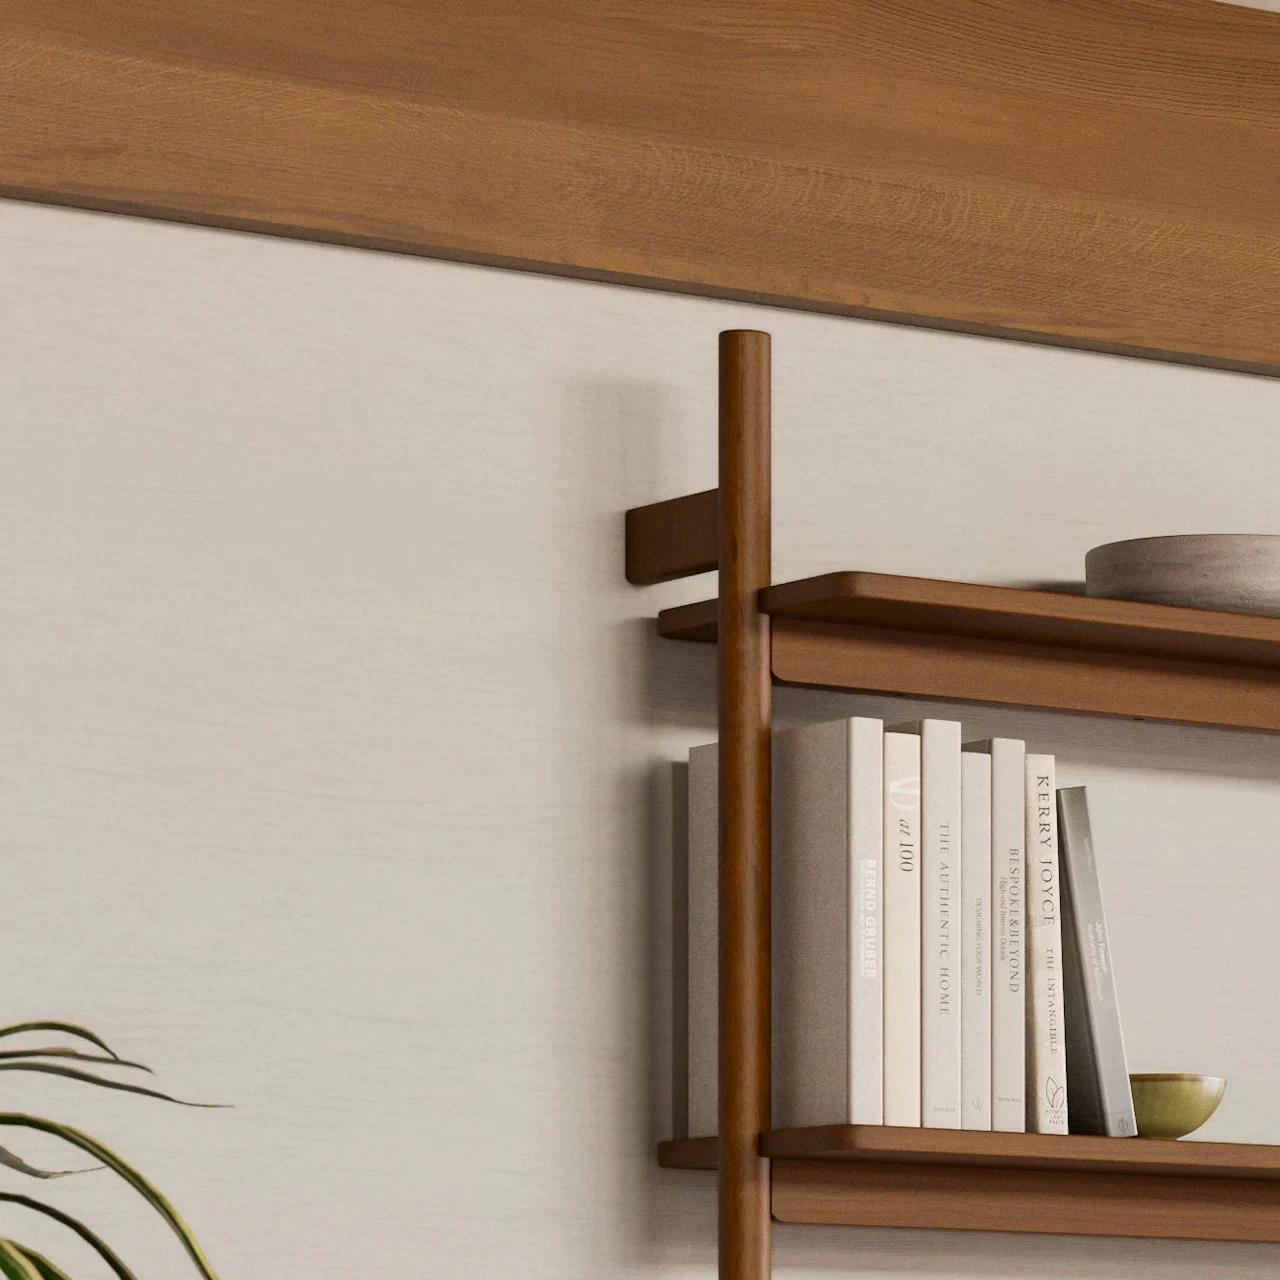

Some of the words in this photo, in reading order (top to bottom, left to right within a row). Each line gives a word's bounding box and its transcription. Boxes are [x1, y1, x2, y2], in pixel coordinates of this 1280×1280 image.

[899, 819, 911, 836] at
[1037, 776, 1052, 849] KERRY
[899, 843, 914, 872] 100
[939, 822, 951, 854] THE
[865, 860, 877, 910] BERND
[1039, 860, 1055, 926] JOYCE
[939, 861, 951, 960] AUTHENTIC
[975, 898, 983, 941] DESIGNING
[865, 917, 877, 980] GRUBER
[1047, 948, 1055, 972] THE
[939, 967, 951, 1017] HOME
[1047, 978, 1059, 1055] INTANGIBLE
